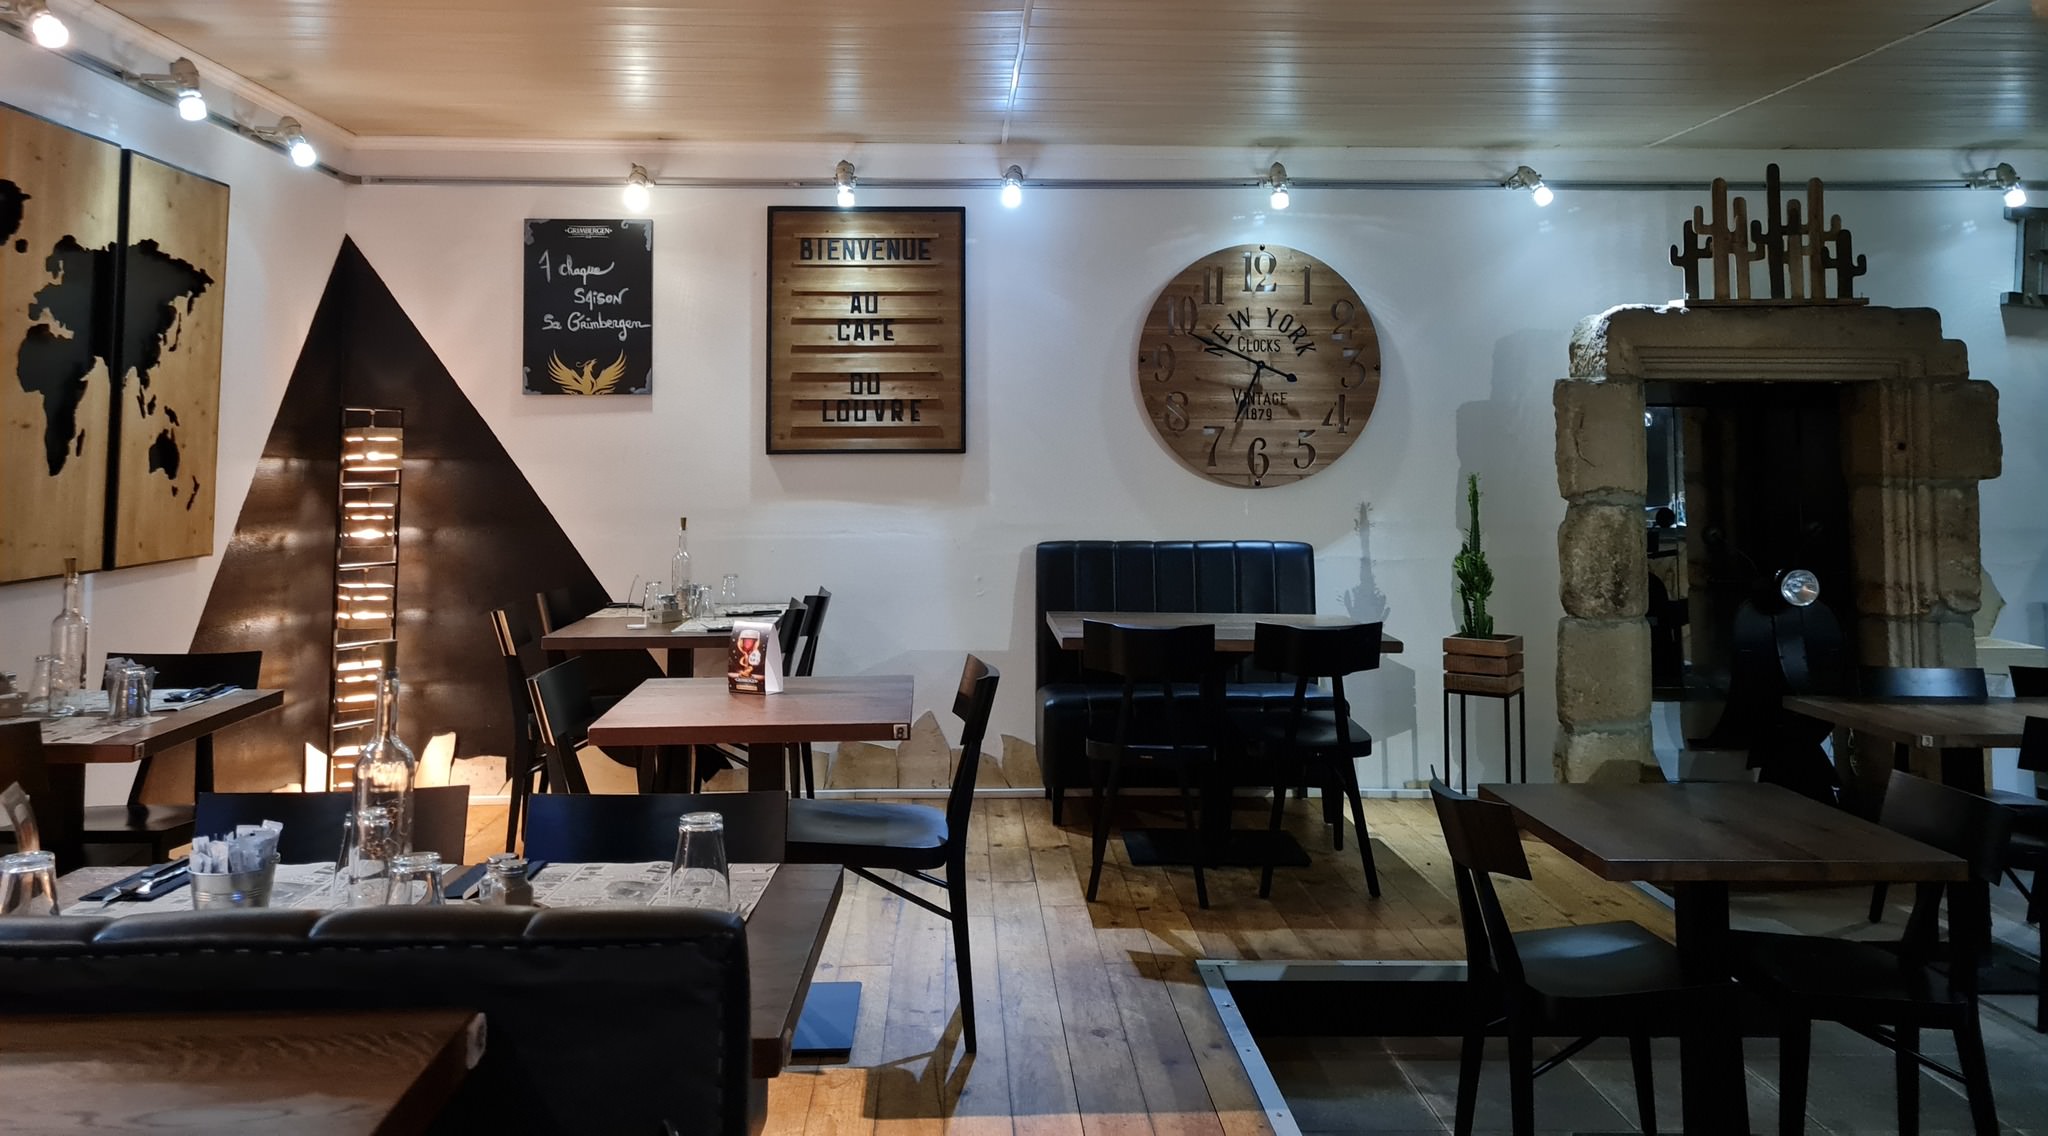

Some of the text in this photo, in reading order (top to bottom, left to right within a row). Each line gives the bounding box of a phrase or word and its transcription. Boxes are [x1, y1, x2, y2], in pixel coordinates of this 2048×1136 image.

[800, 238, 931, 260] BIENVENUE
[1201, 267, 1224, 305] 11
[1242, 250, 1277, 292] 12
[1303, 264, 1313, 306] 1
[850, 293, 878, 314] AU
[1168, 296, 1199, 337] 10
[1331, 299, 1355, 340] 2
[837, 319, 895, 341] CAFE
[1204, 307, 1316, 357] NEW YORK
[1153, 343, 1176, 383] 9
[1341, 347, 1366, 389] 3
[850, 373, 881, 395] DU
[822, 400, 921, 422] LOUVRE
[1164, 391, 1190, 432] 8
[1246, 408, 1272, 420] 1879
[1322, 394, 1351, 434] 4
[1203, 426, 1225, 467] 7
[1247, 437, 1270, 479] 6
[1294, 430, 1316, 469] 5
